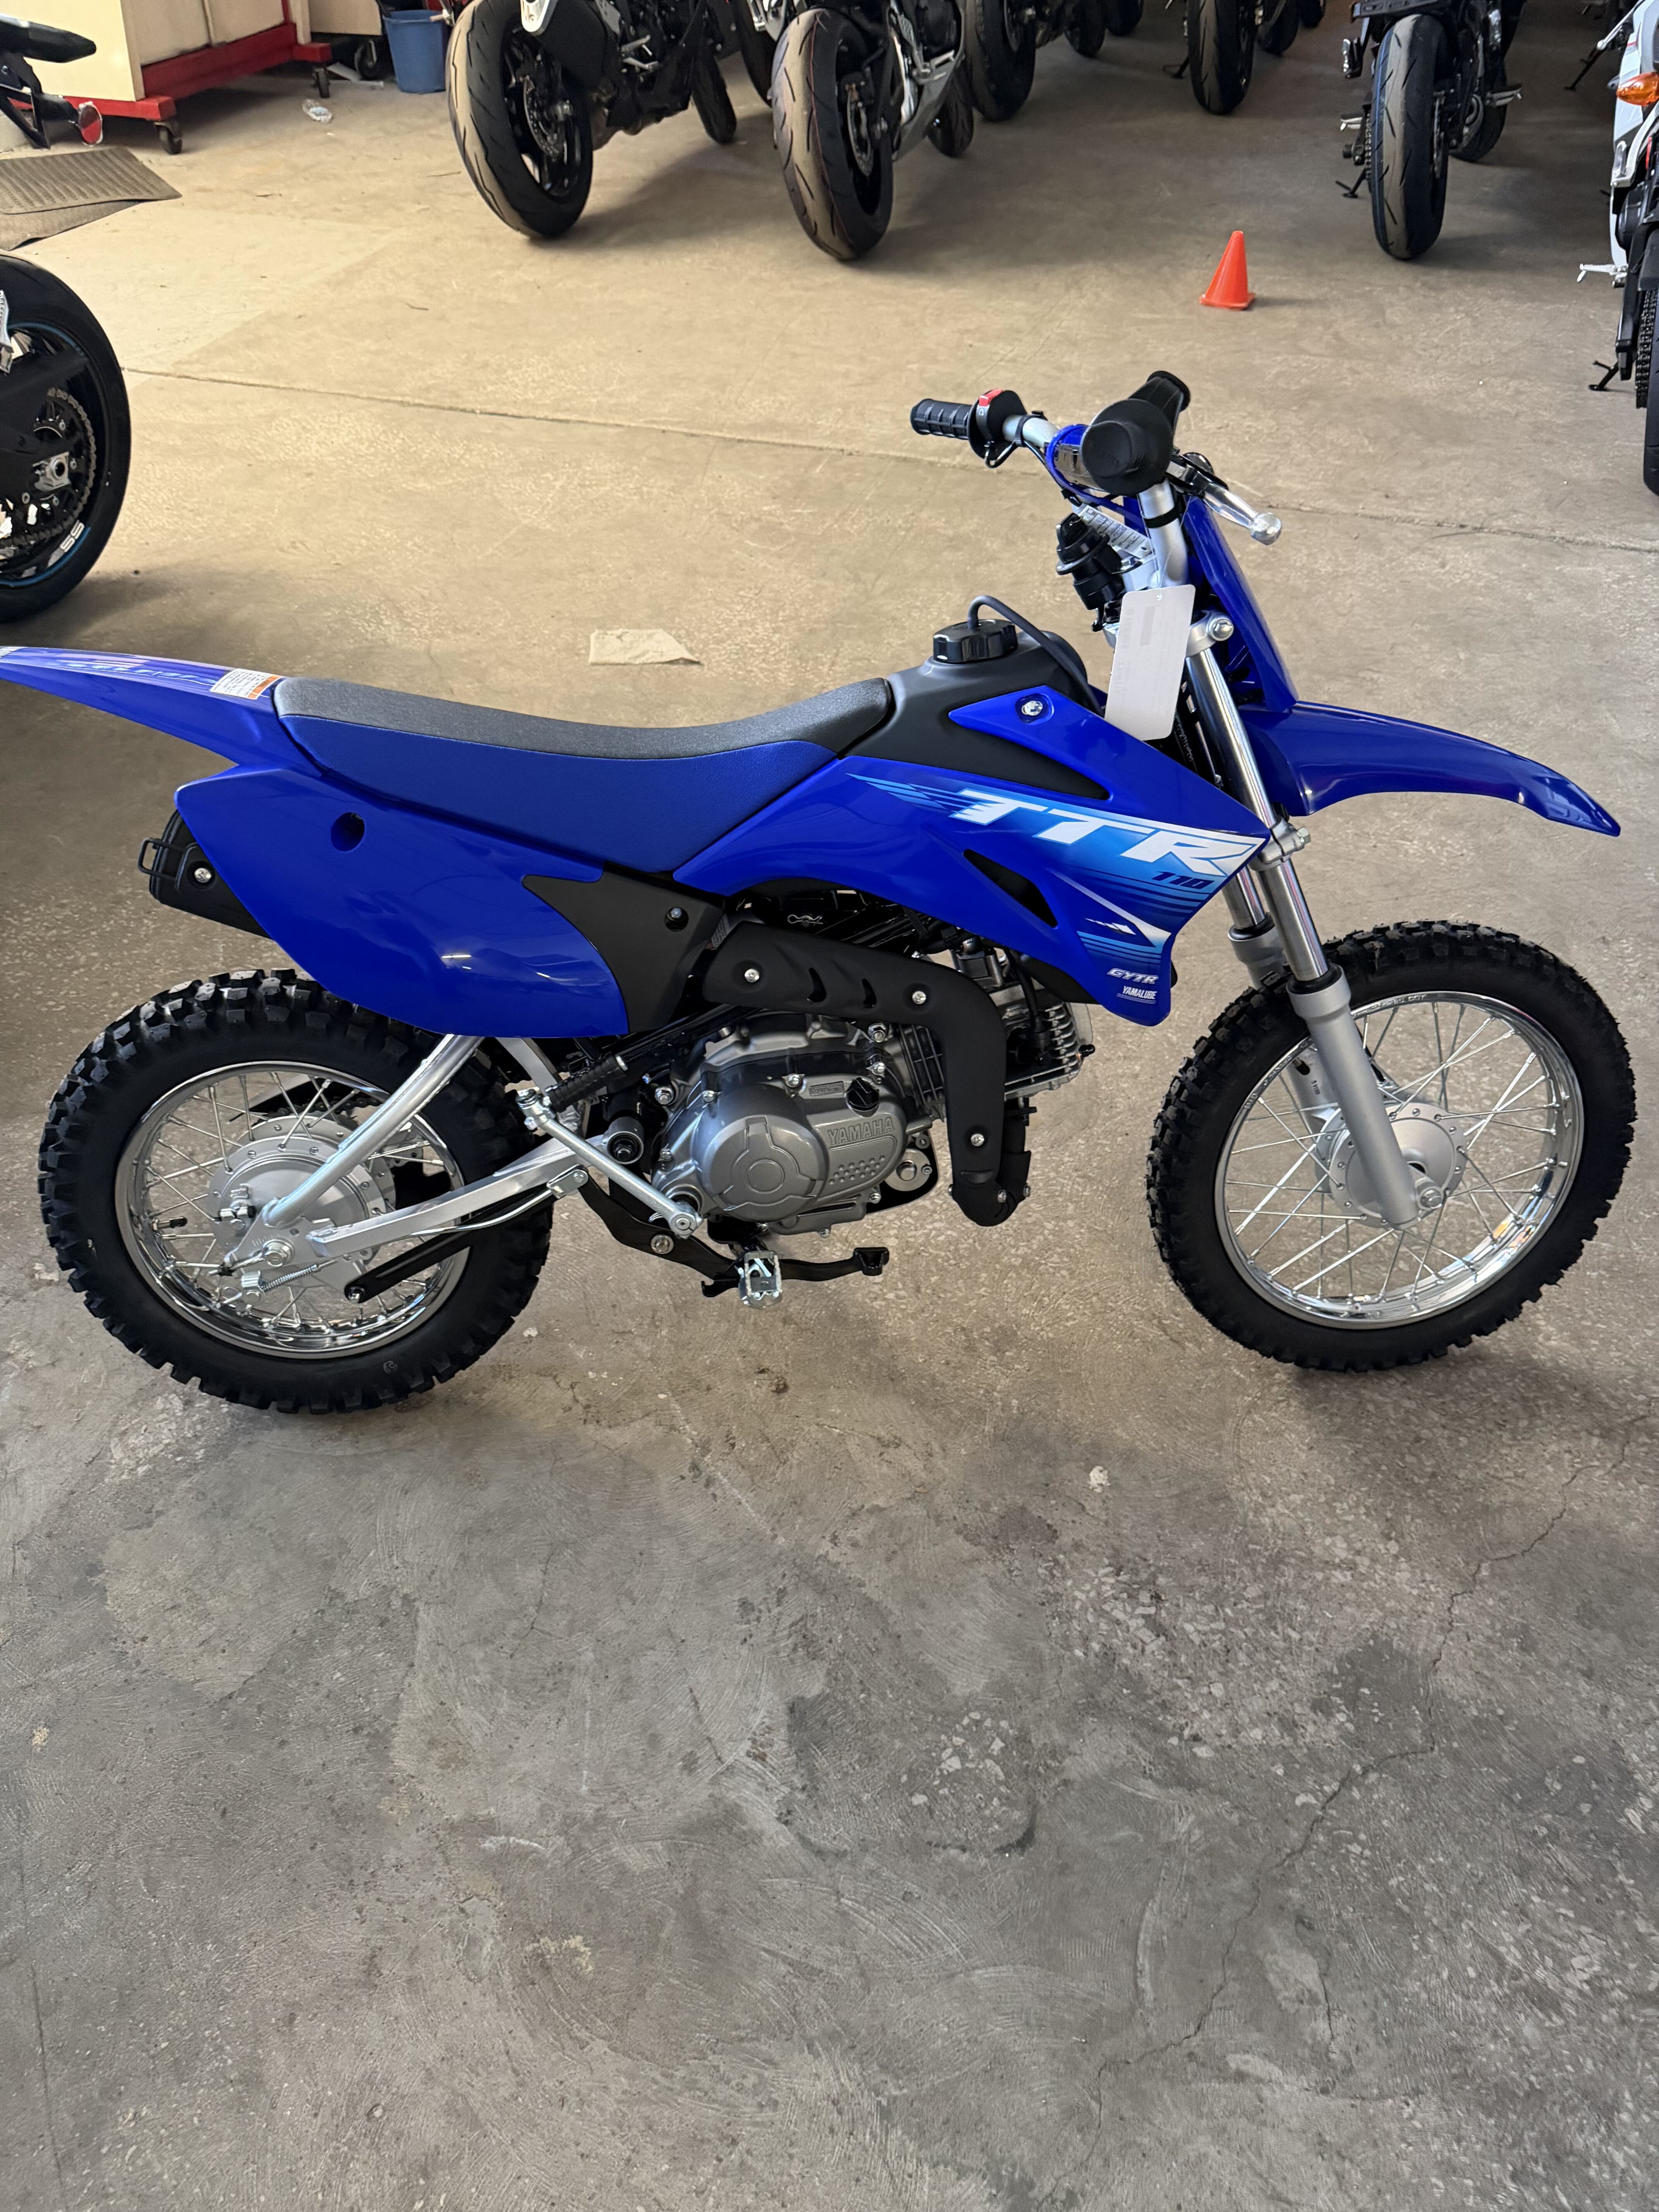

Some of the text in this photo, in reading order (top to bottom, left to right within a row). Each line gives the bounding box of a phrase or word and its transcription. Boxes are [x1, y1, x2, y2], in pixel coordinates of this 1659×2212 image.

[949, 788, 1255, 876] TTR
[1151, 871, 1214, 889] 110
[1107, 968, 1159, 984] GYTR
[1122, 986, 1157, 1000] YAMALUBE
[827, 1117, 895, 1146] YAMAHA
